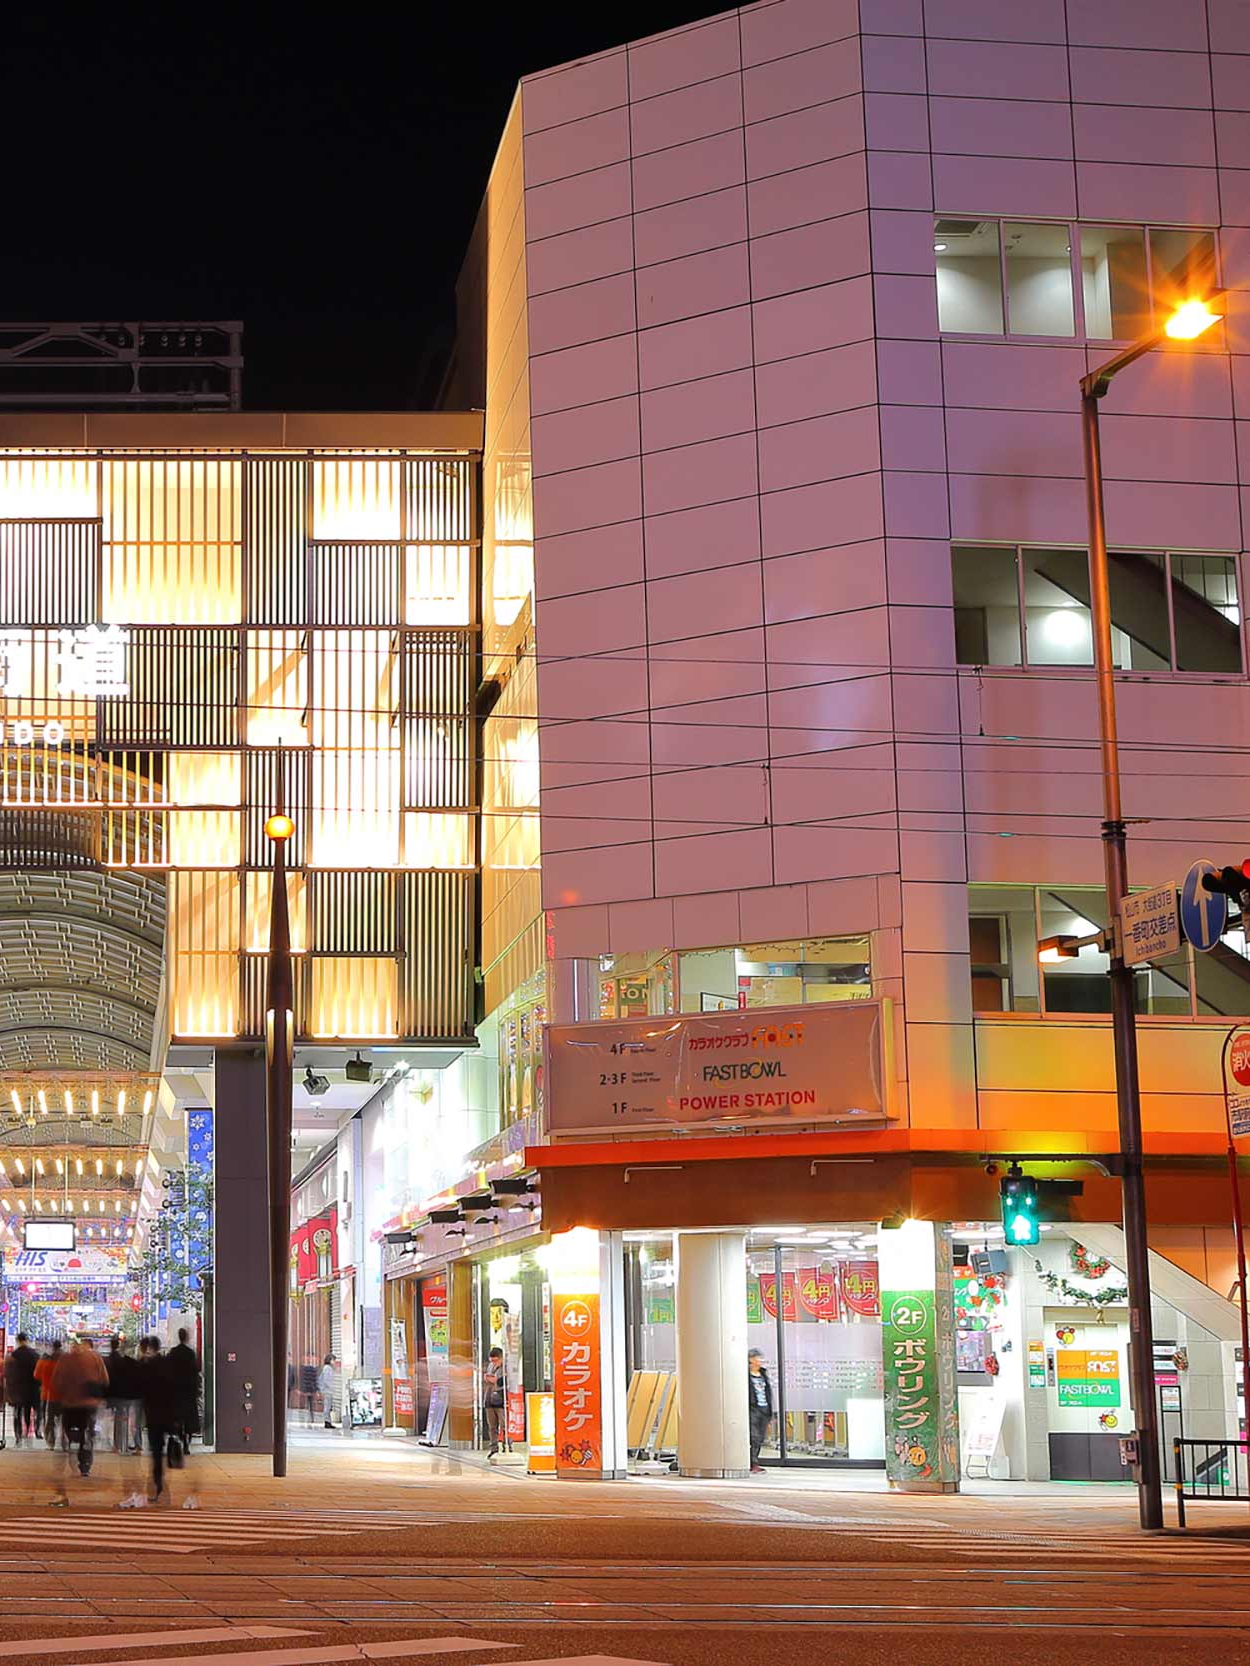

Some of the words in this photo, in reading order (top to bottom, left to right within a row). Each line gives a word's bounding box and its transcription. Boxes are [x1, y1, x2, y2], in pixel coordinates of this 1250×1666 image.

[1124, 912, 1177, 944] 一番町交差点
[688, 1033, 750, 1050] カラオケクラブ
[612, 1101, 628, 1114] 1F
[679, 1095, 740, 1111] POWER
[744, 1089, 816, 1108] STATION
[15, 1251, 48, 1267] HIS
[802, 1279, 830, 1299] 4円
[848, 1273, 875, 1293] 4円
[563, 1310, 588, 1328] 4F
[896, 1306, 923, 1325] 2F
[562, 1341, 593, 1432] カラオケ
[893, 1338, 931, 1430] ボウリング
[1059, 1384, 1115, 1396] FASTBOWL
